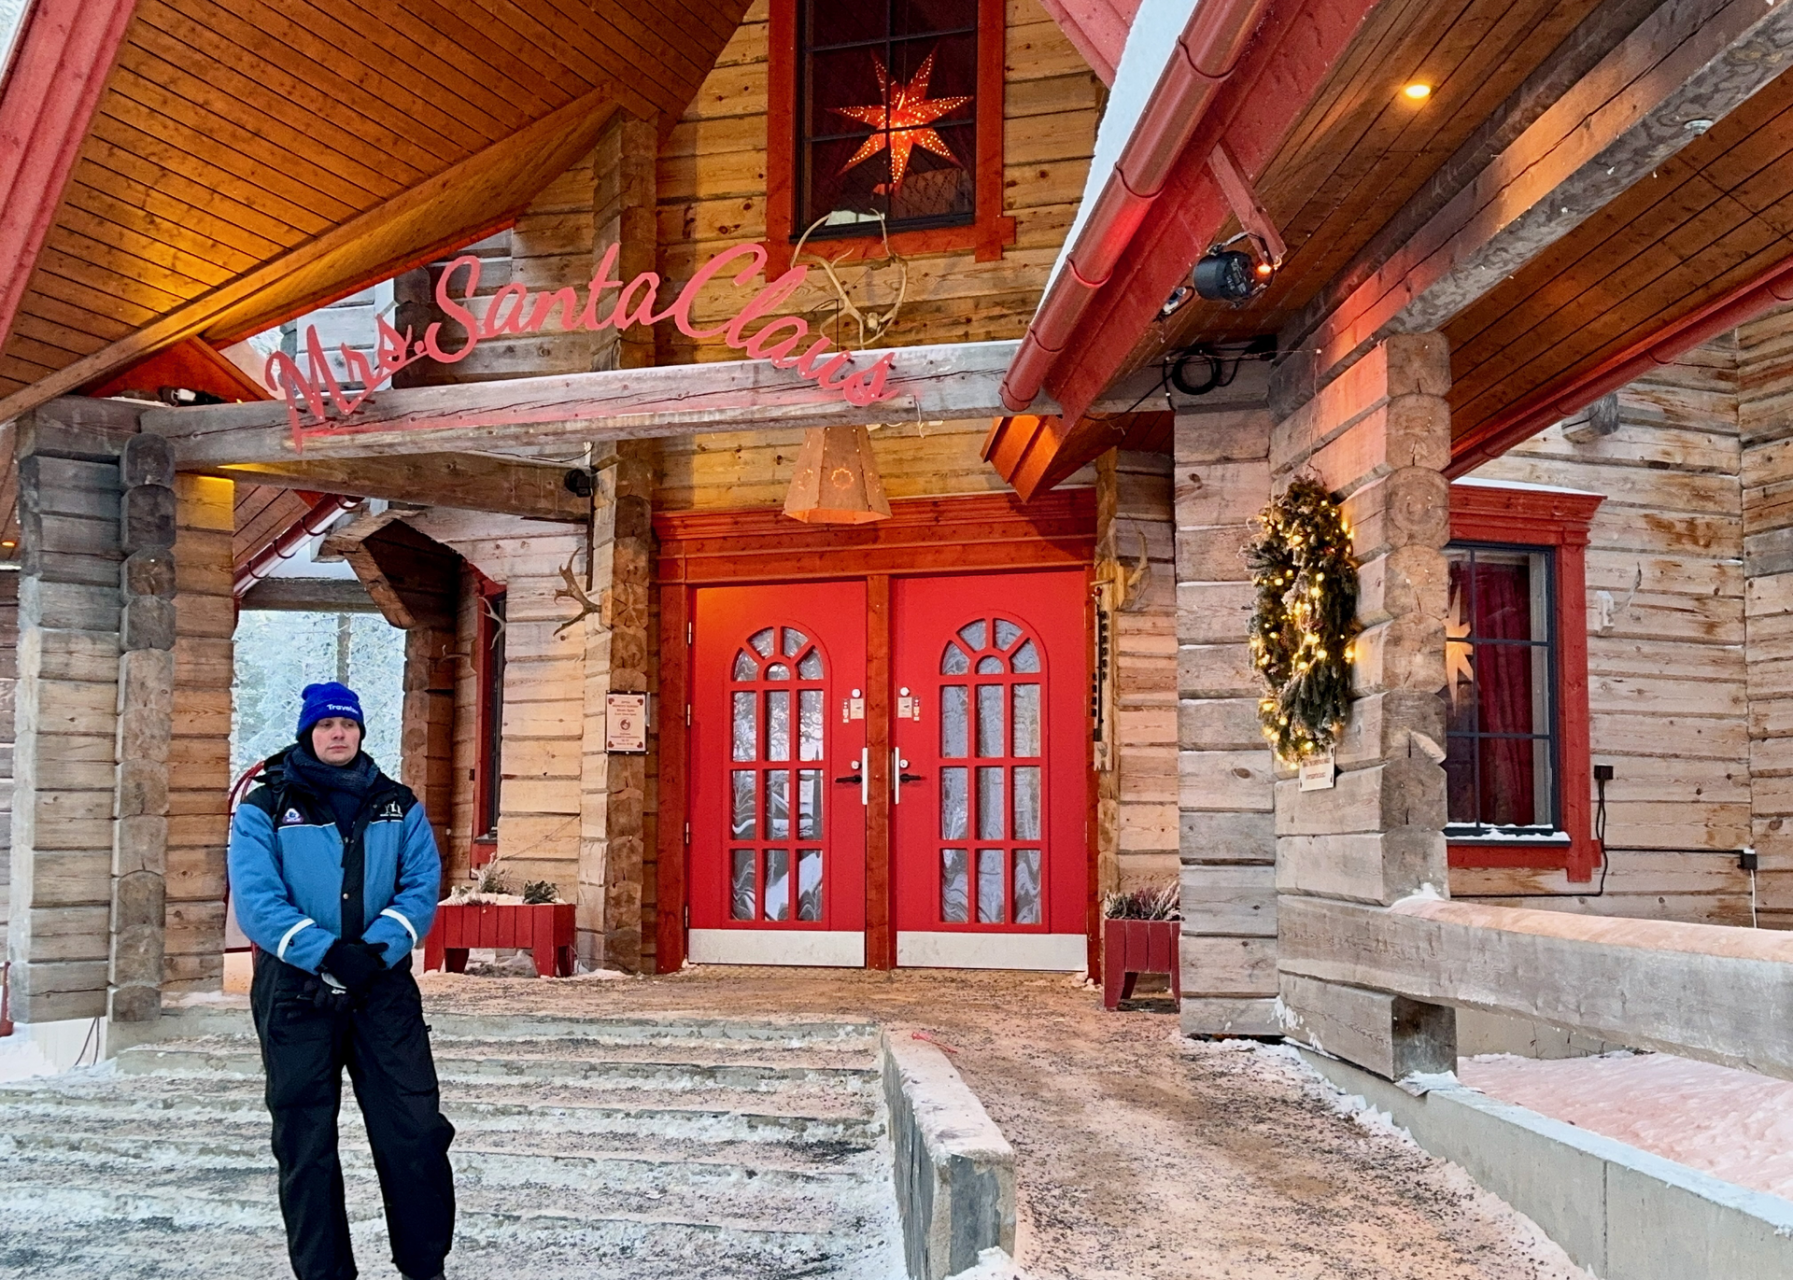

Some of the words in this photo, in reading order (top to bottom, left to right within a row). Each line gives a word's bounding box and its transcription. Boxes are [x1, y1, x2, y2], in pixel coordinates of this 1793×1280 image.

[265, 314, 427, 453] Mrs.
[426, 242, 676, 363] Santa
[674, 242, 900, 407] Claus
